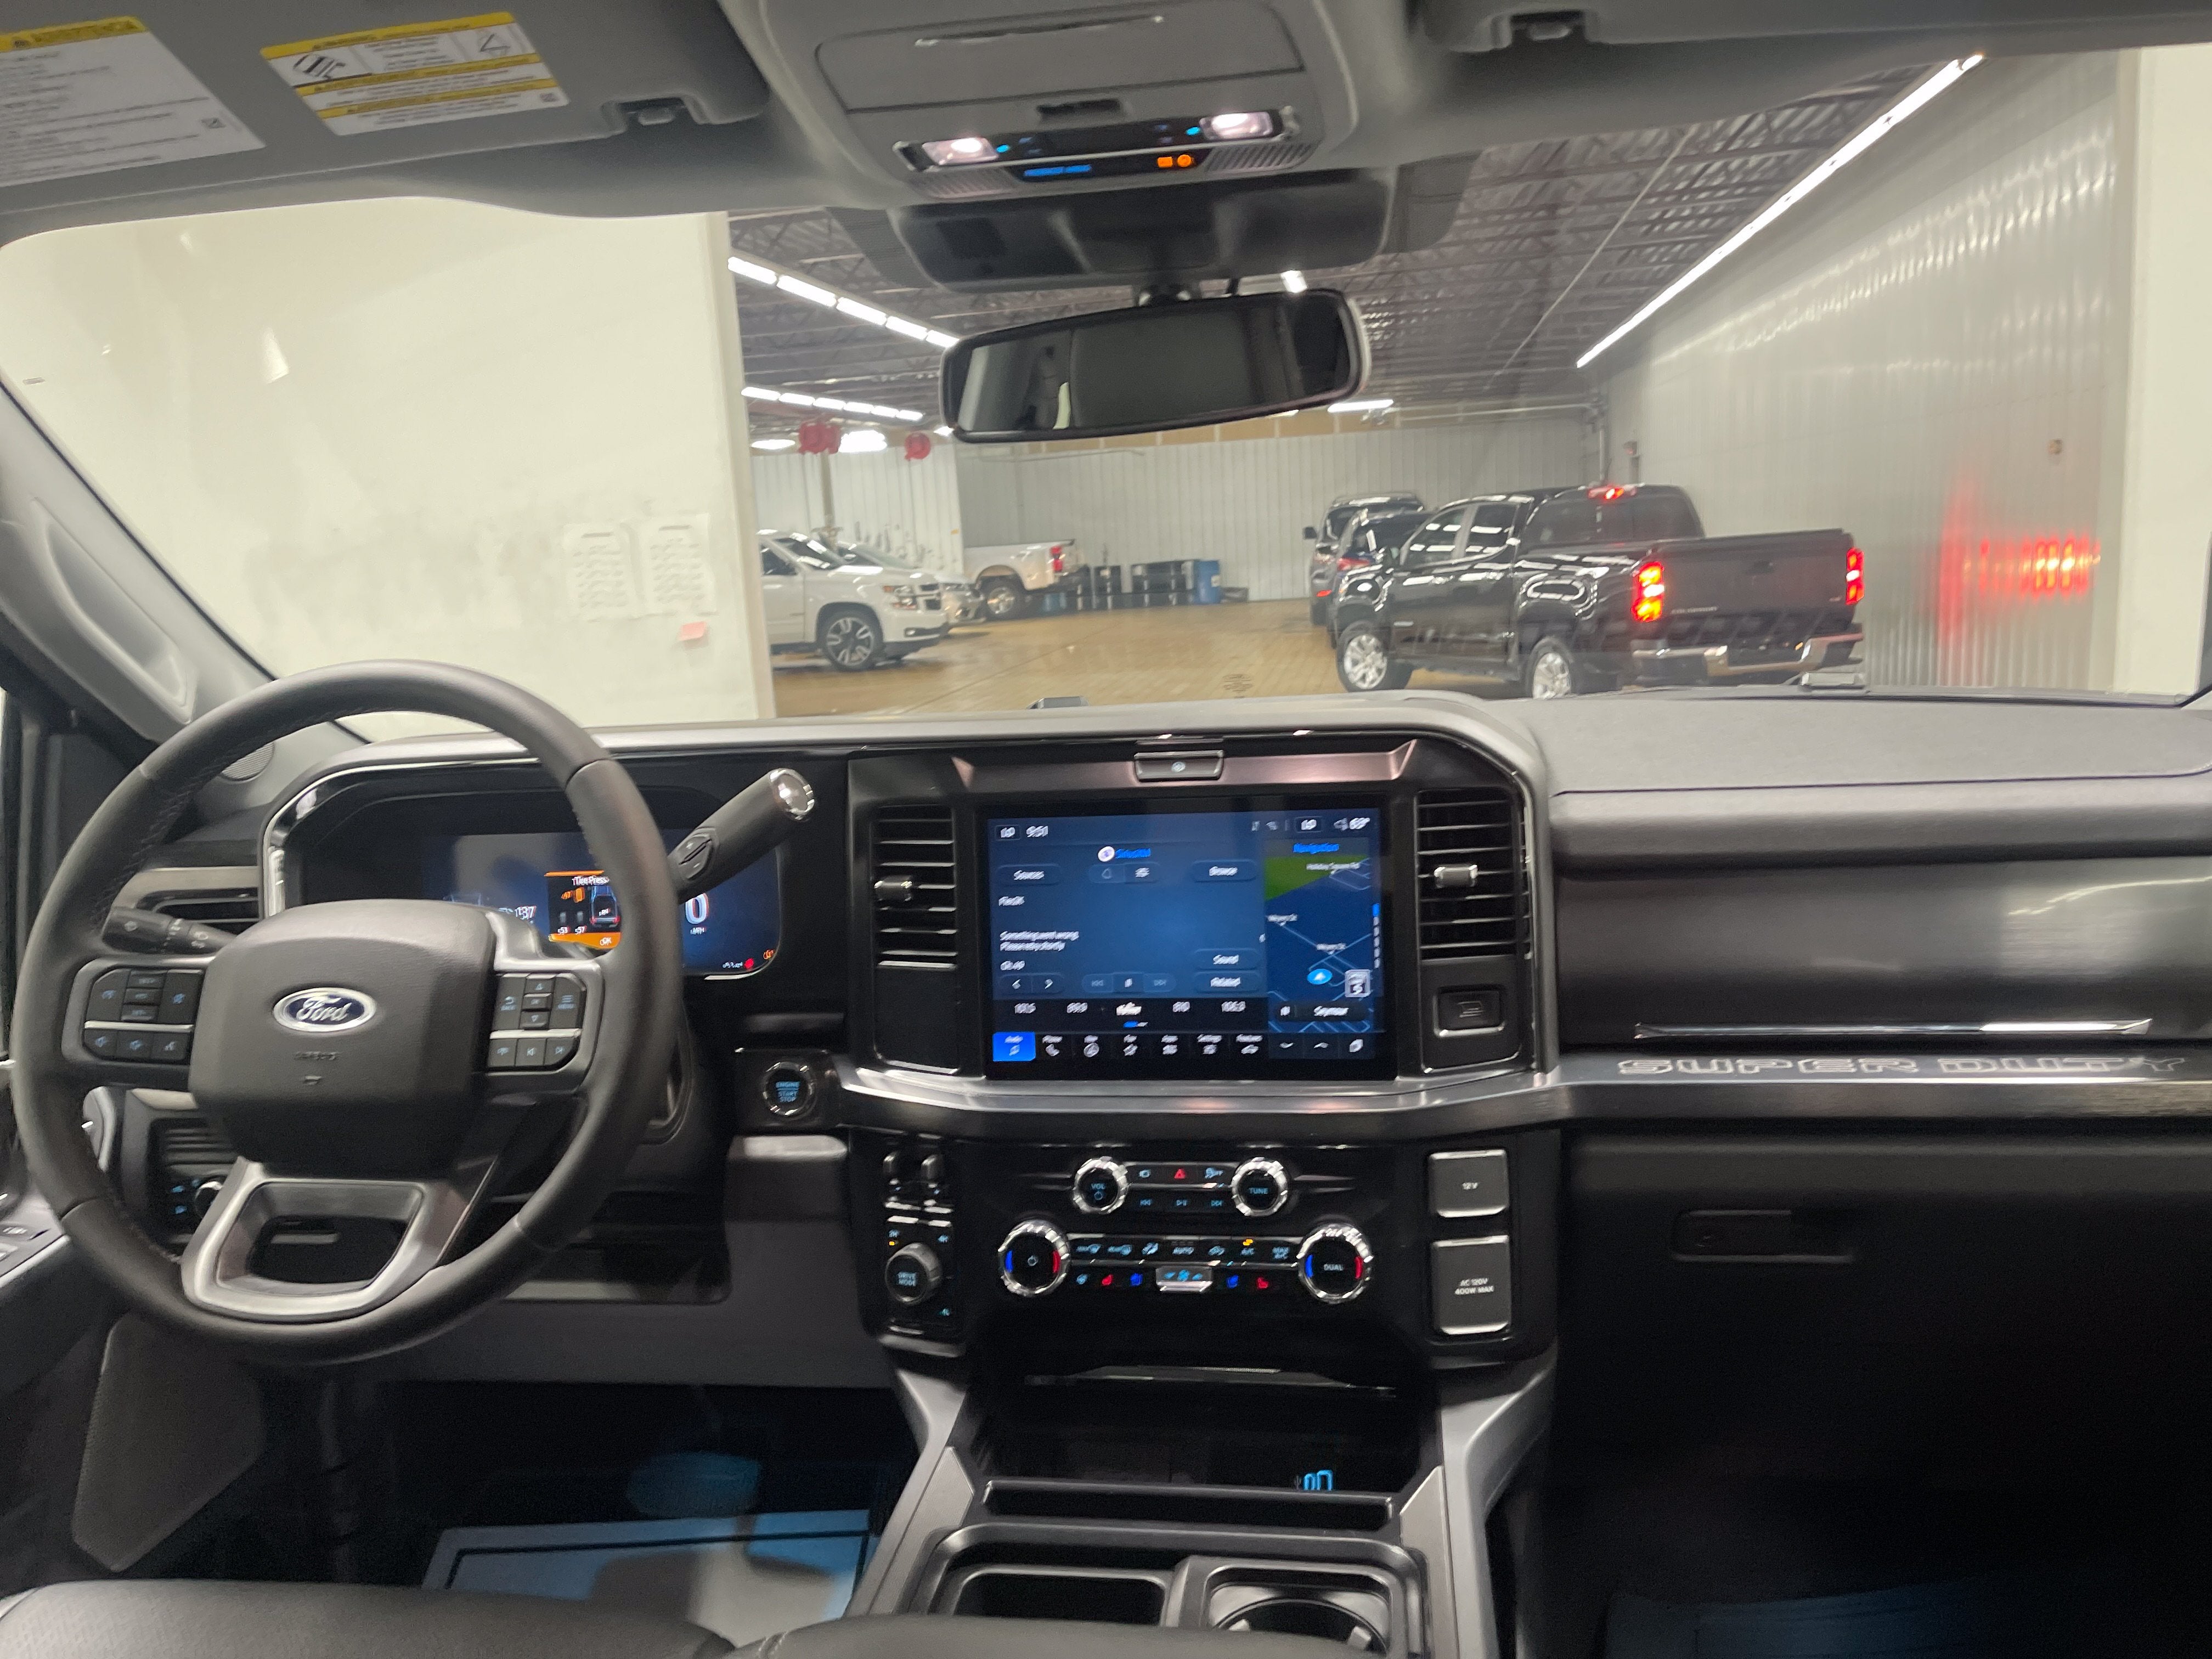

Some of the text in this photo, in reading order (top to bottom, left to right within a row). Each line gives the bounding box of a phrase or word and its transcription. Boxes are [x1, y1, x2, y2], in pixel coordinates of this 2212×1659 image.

[296, 996, 353, 1021] Ford
[1618, 1058, 2185, 1074] SUPER DUTY
[1460, 1279, 1470, 1287] AC
